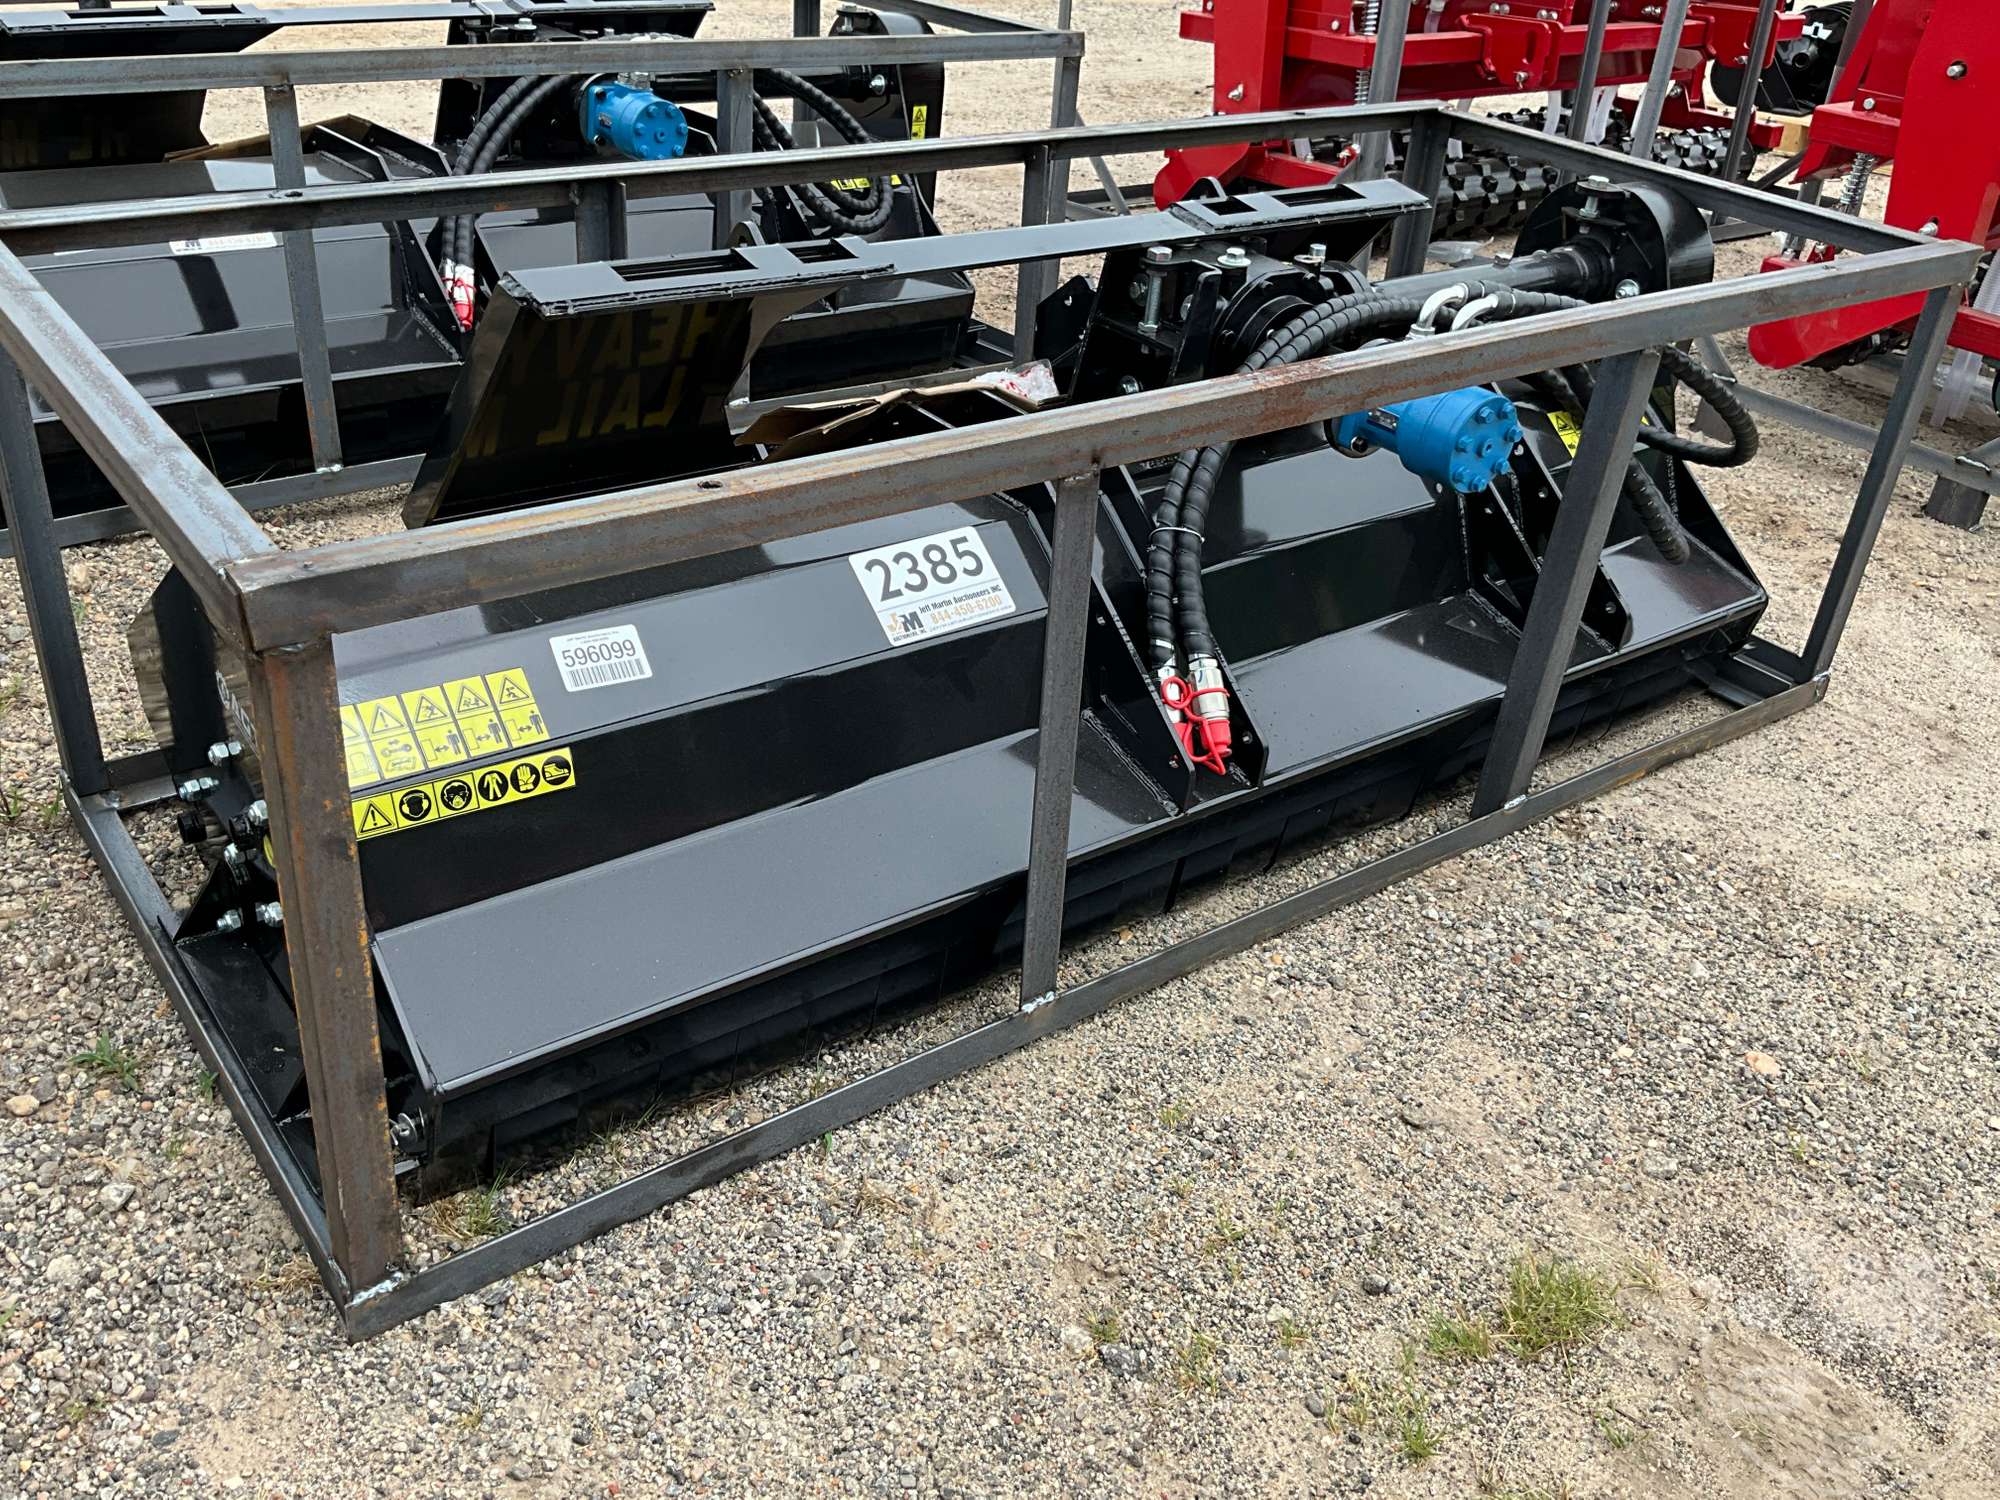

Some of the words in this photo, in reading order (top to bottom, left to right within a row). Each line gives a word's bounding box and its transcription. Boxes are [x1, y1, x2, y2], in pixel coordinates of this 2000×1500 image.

[864, 536, 983, 601] 2385
[918, 604, 931, 614] Jeff
[932, 598, 953, 610] Martin
[953, 588, 990, 604] Auctioneers
[991, 584, 1002, 593] INC
[561, 639, 636, 668] 596099
